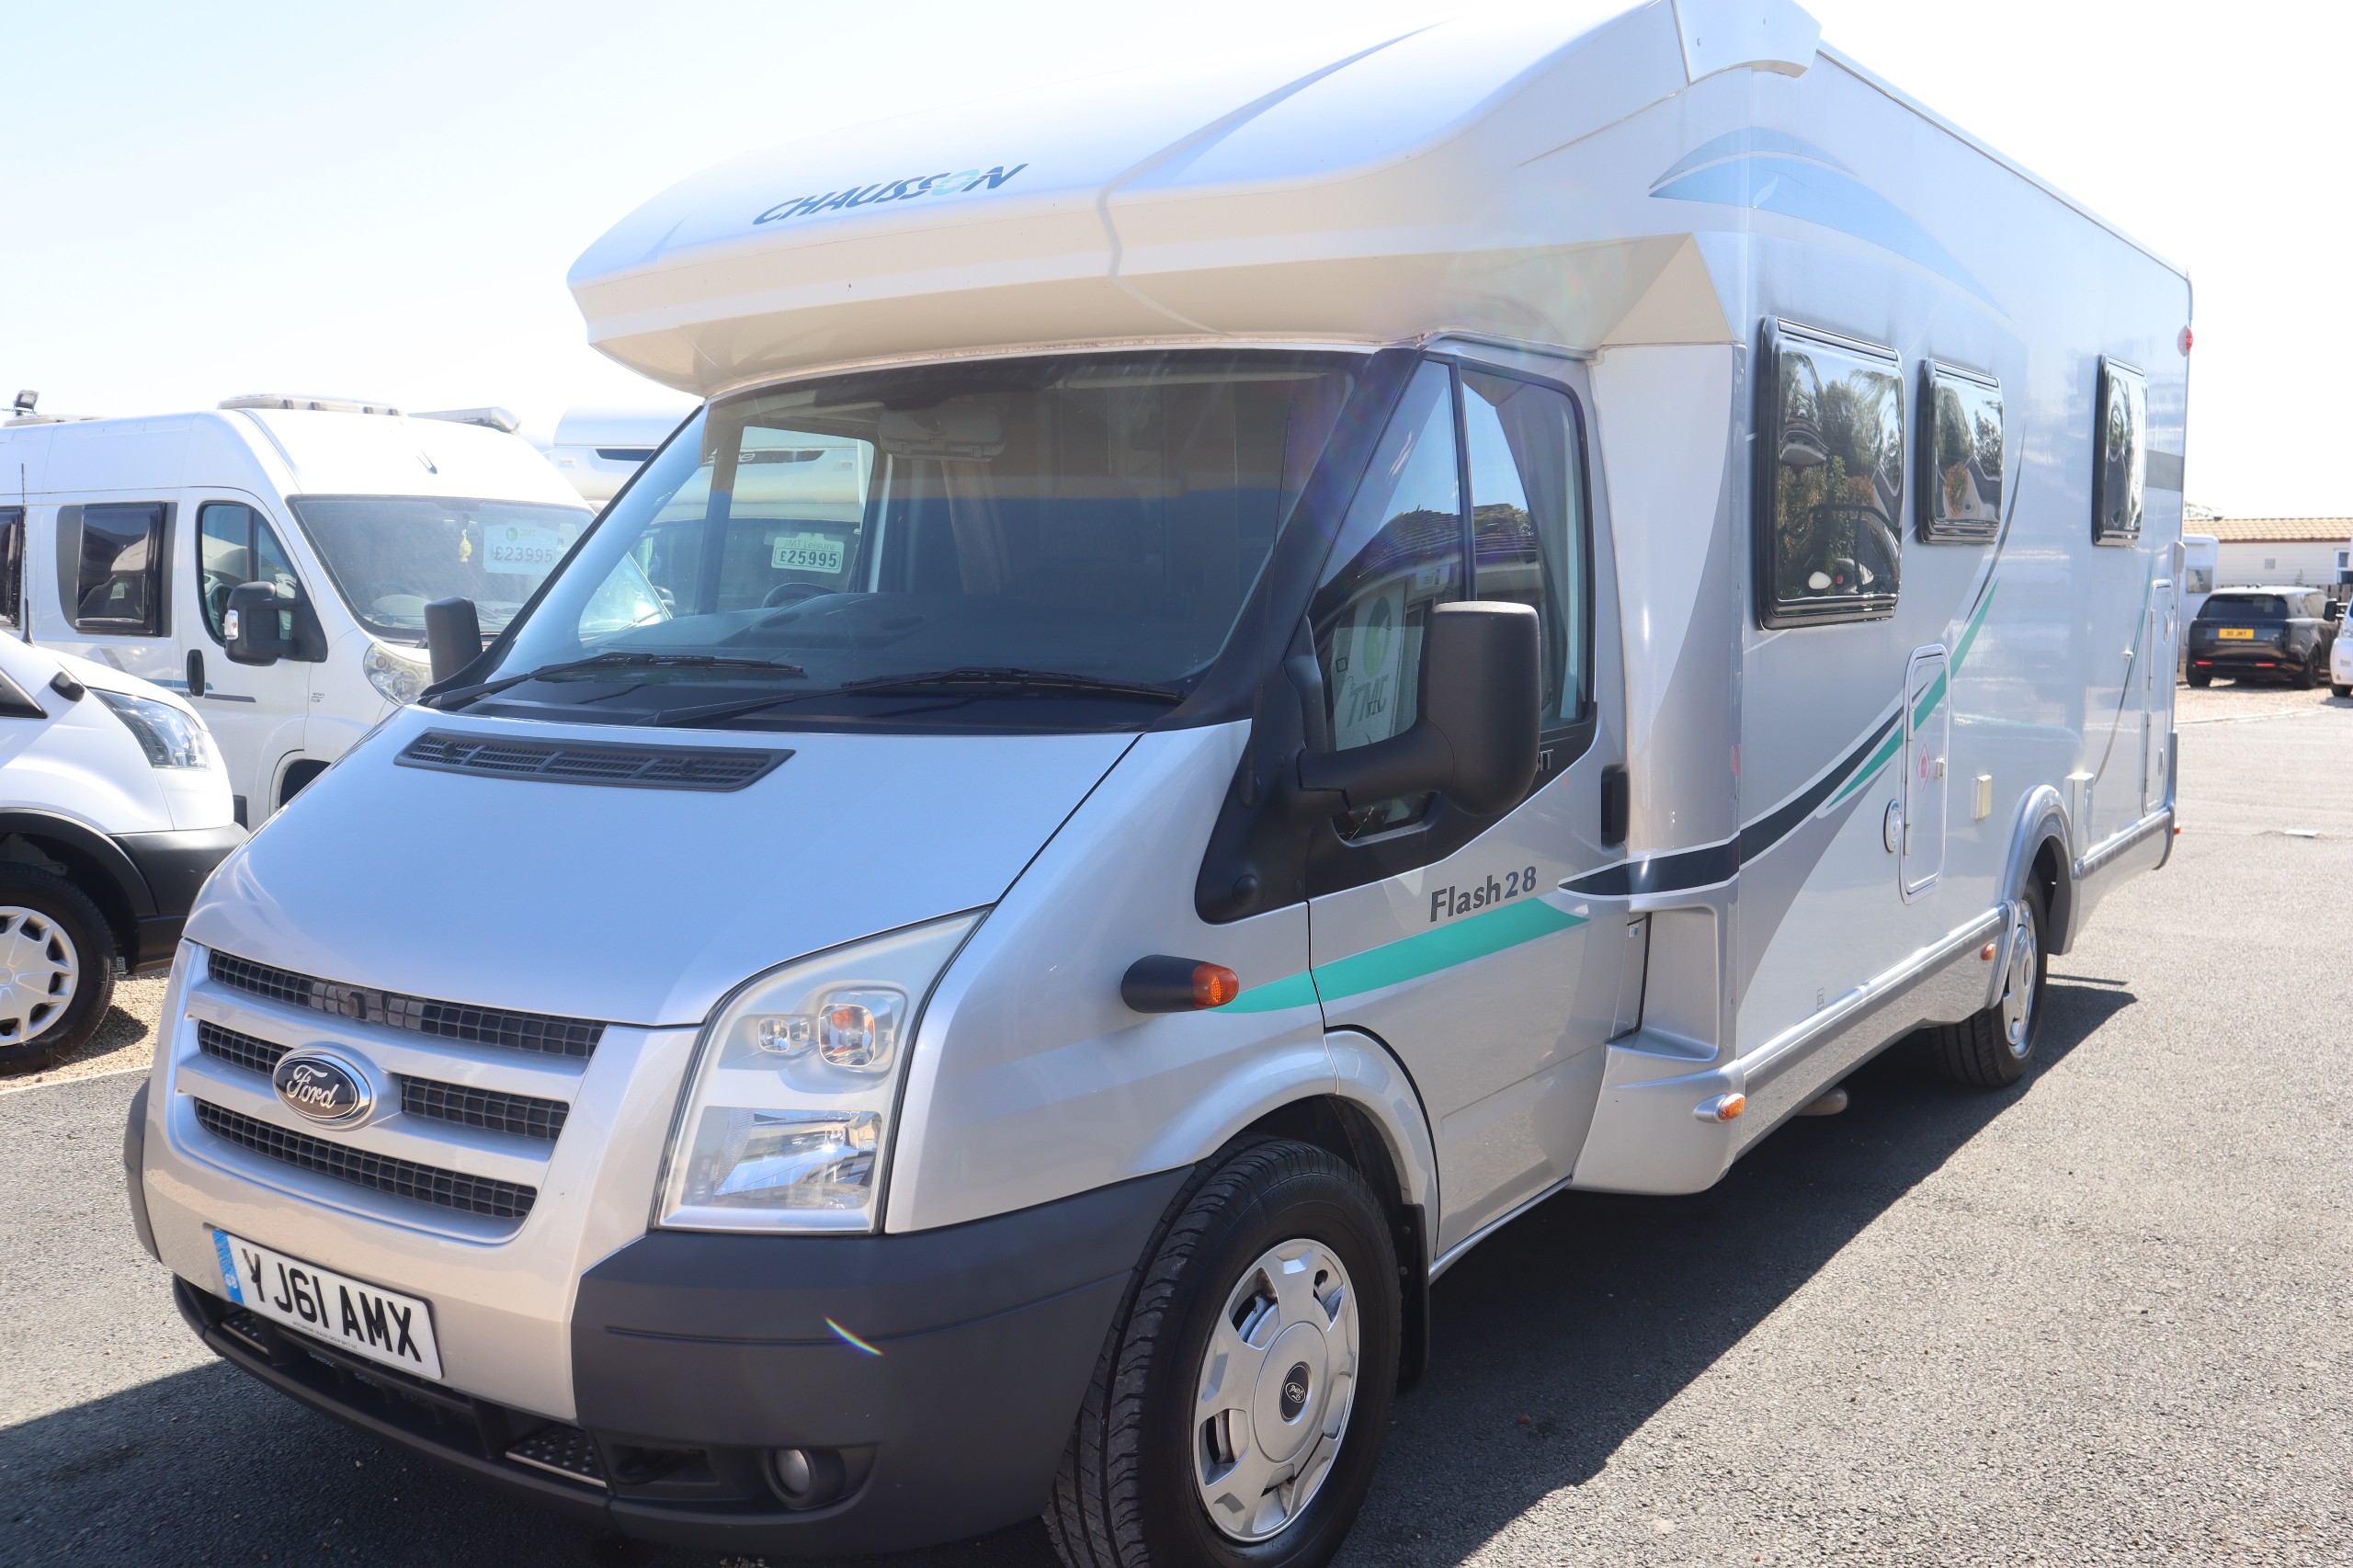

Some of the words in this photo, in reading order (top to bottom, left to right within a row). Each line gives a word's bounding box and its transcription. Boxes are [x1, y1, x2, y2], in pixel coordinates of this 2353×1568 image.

[753, 163, 1029, 225] CHAUSSON
[783, 539, 801, 548] JMT
[804, 540, 836, 551] Leisure
[493, 546, 553, 563] £23995
[779, 551, 837, 567] £25995
[286, 1063, 340, 1109] Ford
[241, 1247, 330, 1330] YJ61
[339, 1284, 423, 1363] AMX
[1289, 1384, 1304, 1402] Ford
